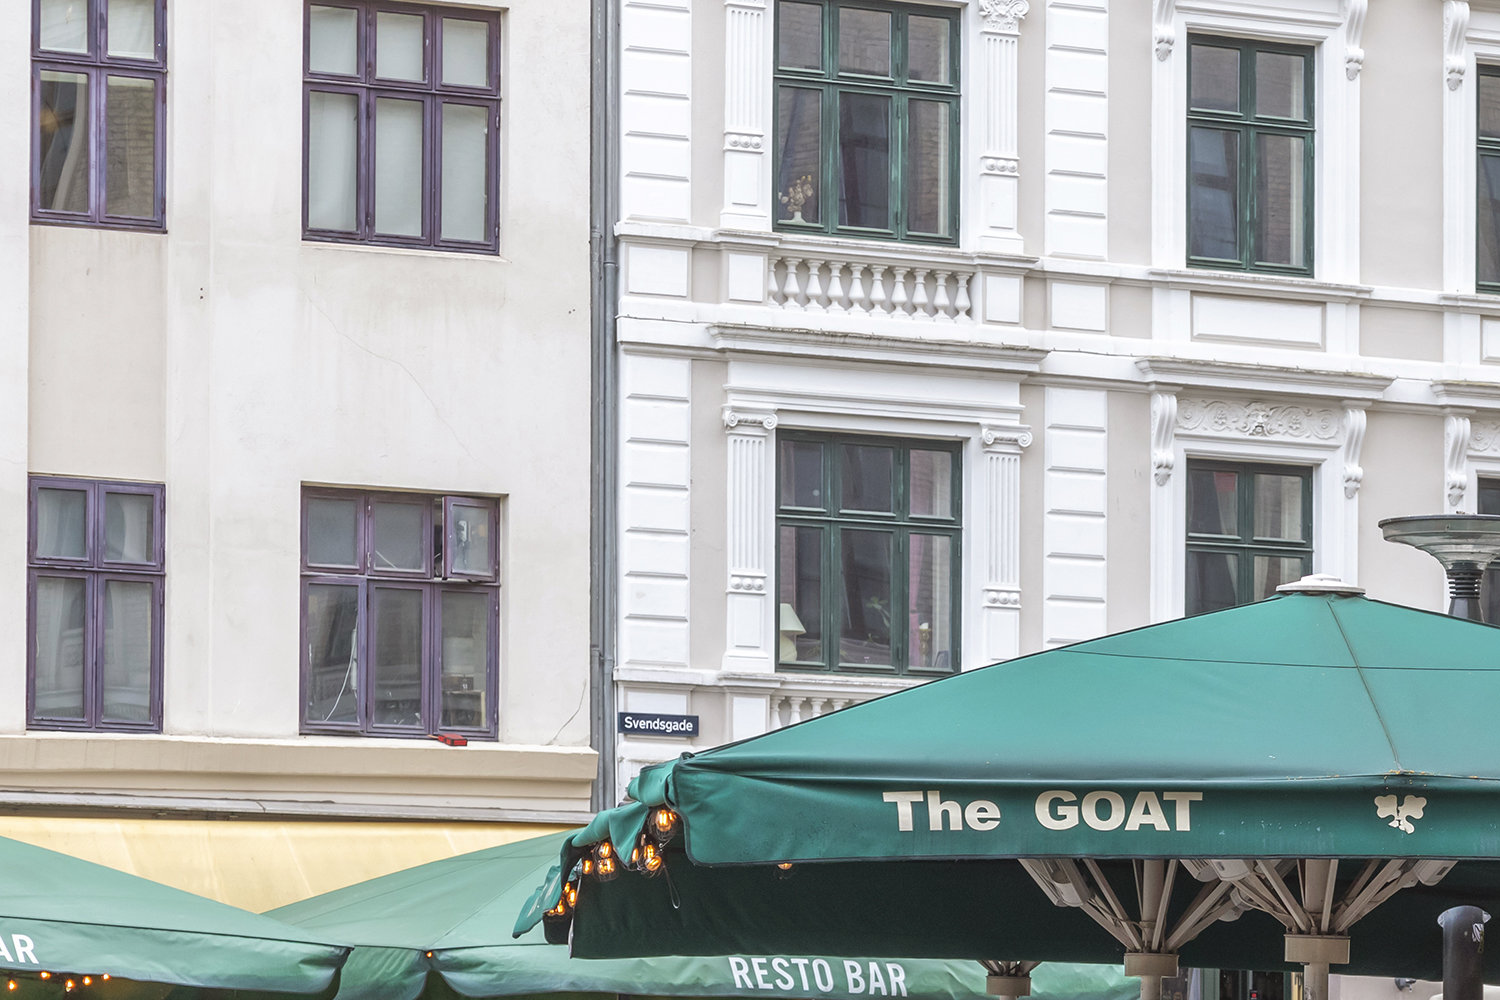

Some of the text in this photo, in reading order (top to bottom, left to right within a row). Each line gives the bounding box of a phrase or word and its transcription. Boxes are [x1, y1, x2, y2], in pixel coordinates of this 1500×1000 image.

[624, 716, 693, 733] Svendsgade
[882, 790, 1203, 832] The GOAT
[0, 933, 39, 964] AR
[728, 956, 908, 998] RESTO BAR
